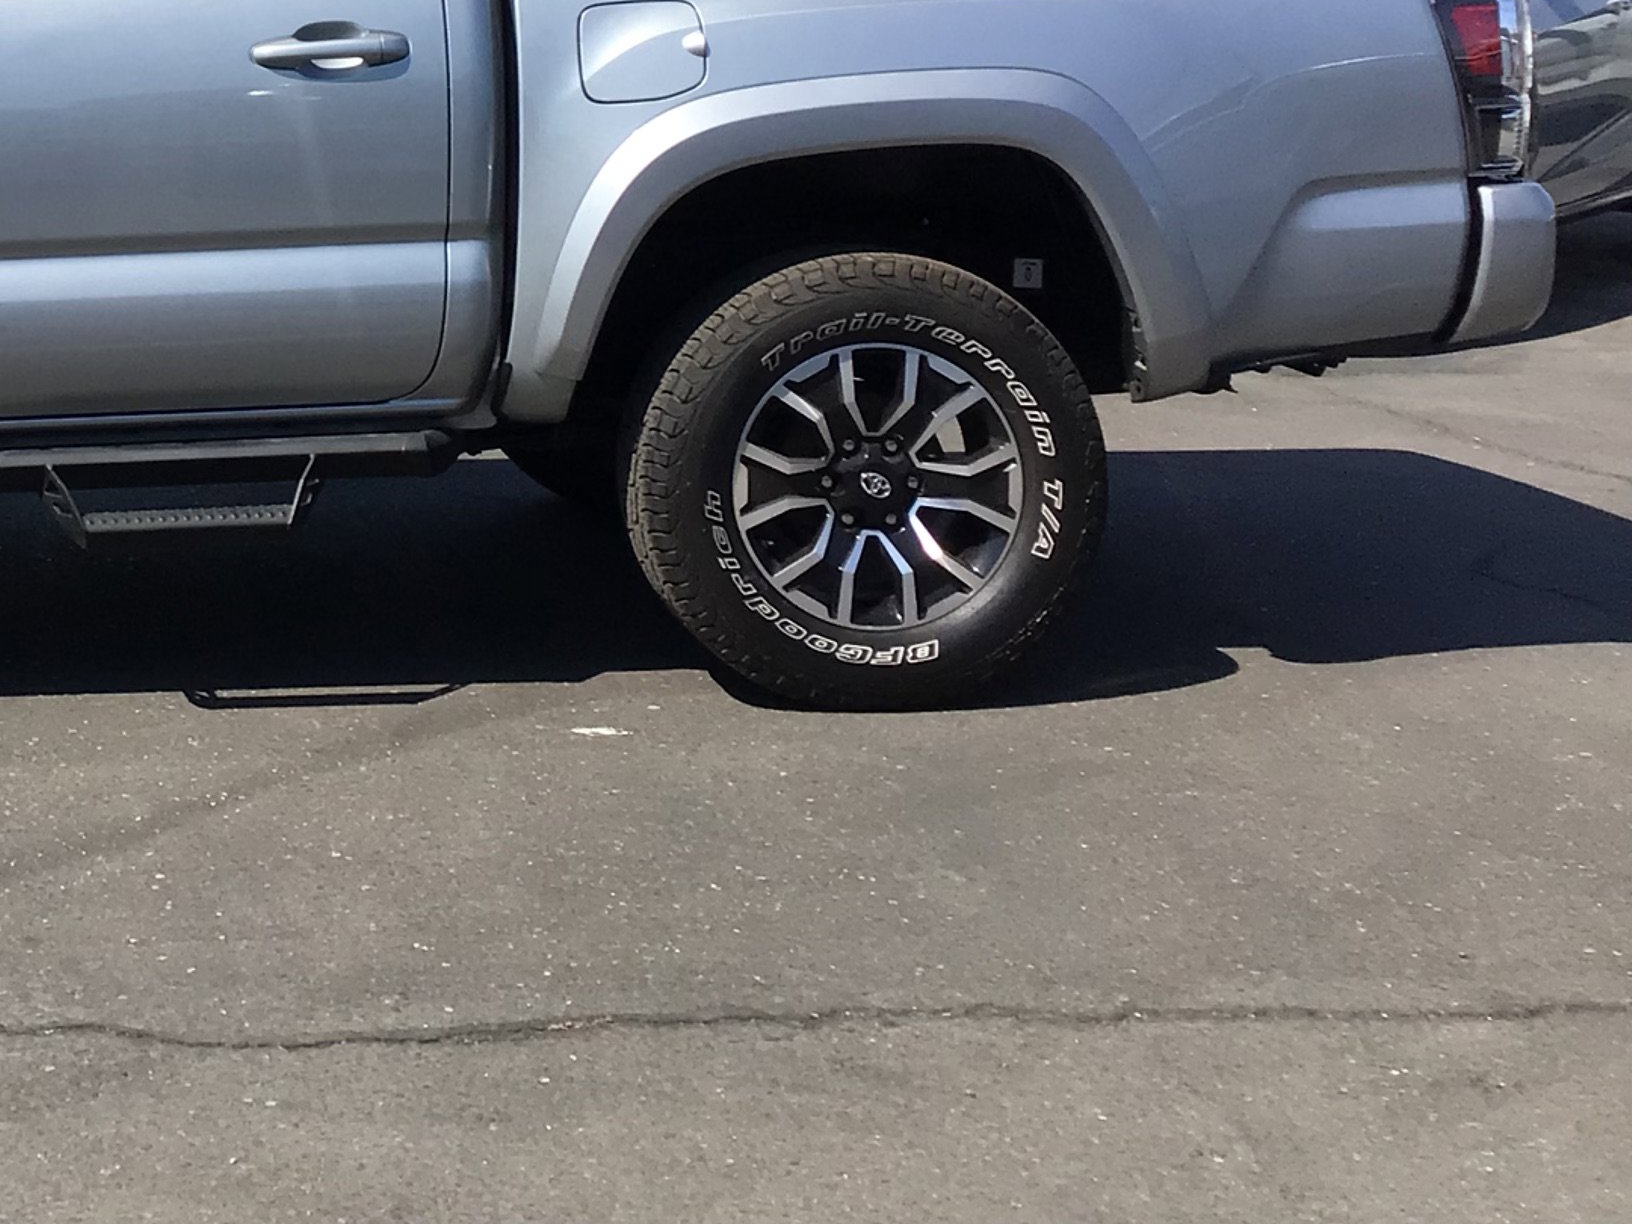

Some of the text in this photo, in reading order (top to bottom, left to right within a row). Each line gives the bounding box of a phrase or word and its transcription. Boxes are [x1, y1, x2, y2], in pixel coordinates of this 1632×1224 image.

[761, 311, 1065, 561] Trail-Terrain T/A
[704, 490, 940, 666] BFGoodrich
